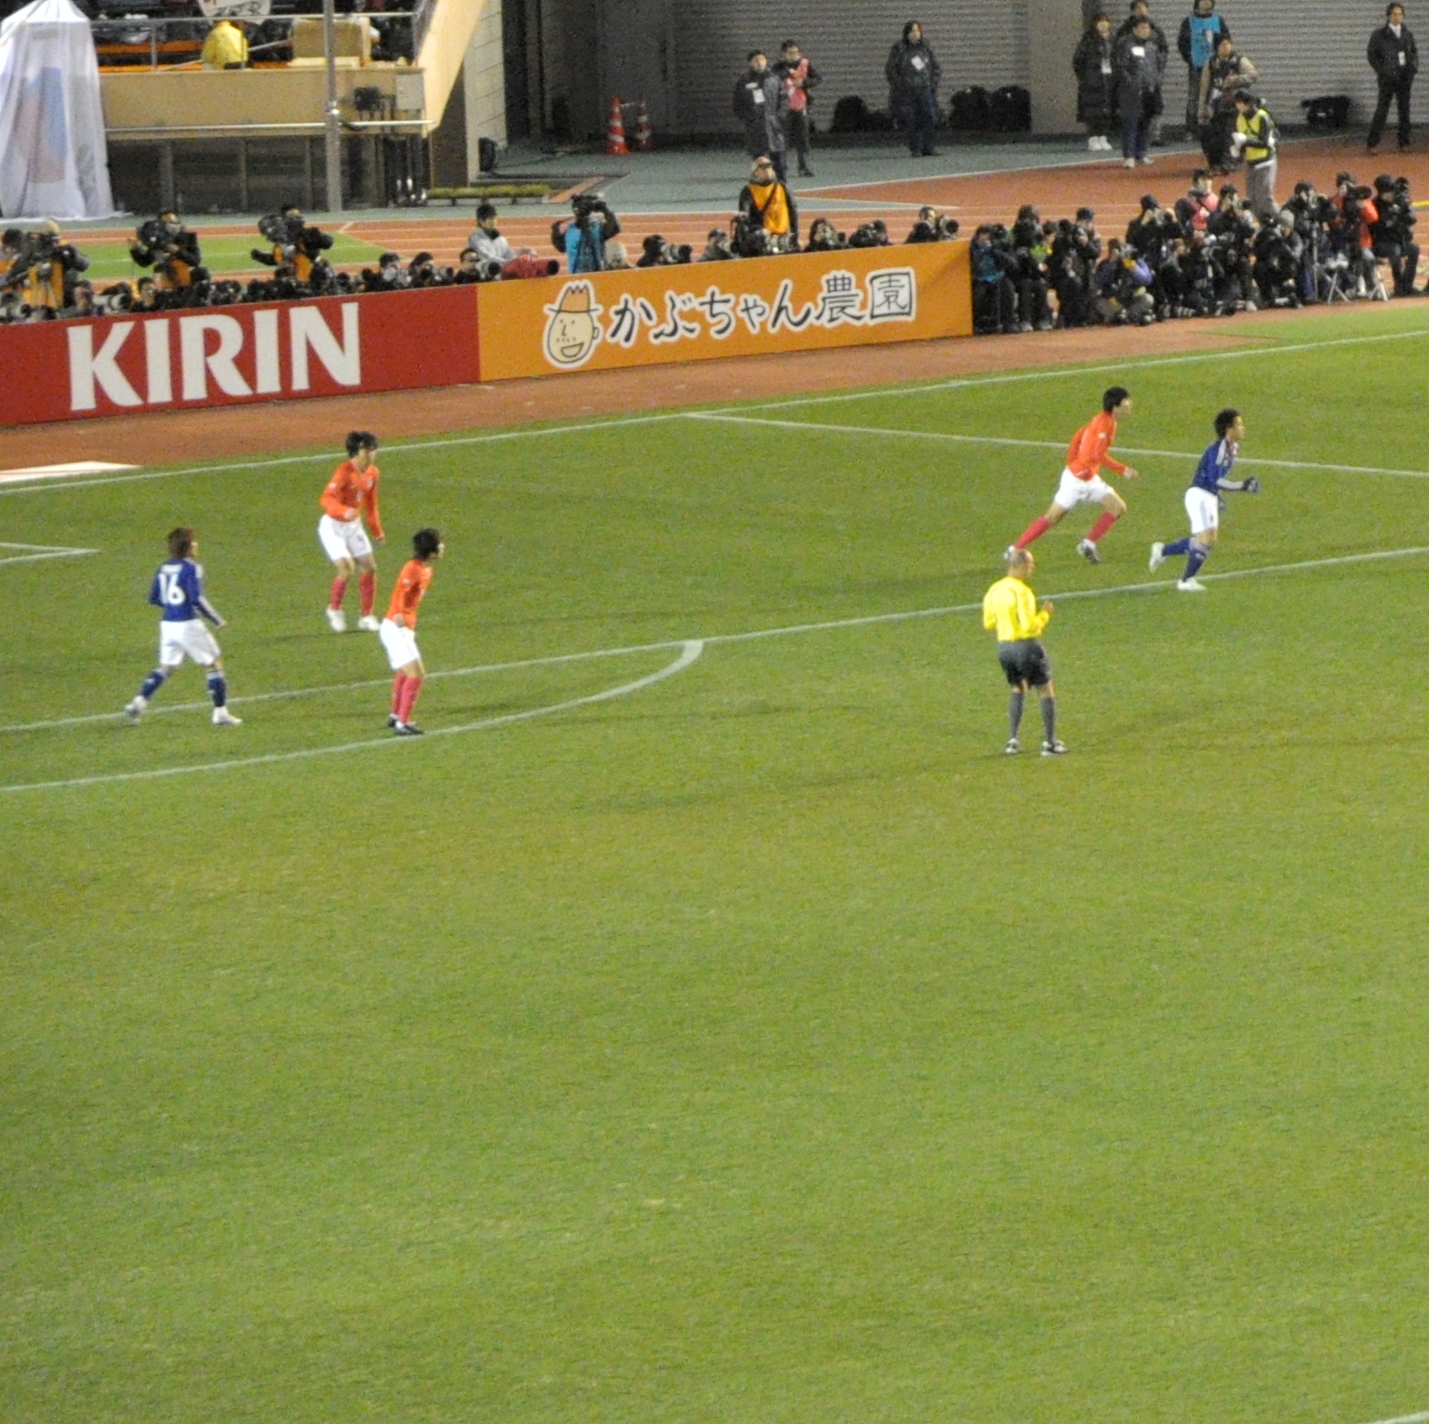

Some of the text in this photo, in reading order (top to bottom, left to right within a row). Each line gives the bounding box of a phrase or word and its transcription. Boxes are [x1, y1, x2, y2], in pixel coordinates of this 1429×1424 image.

[608, 268, 915, 345] かぶちゃん農園
[67, 302, 362, 412] KIRIN
[158, 572, 186, 606] 16
